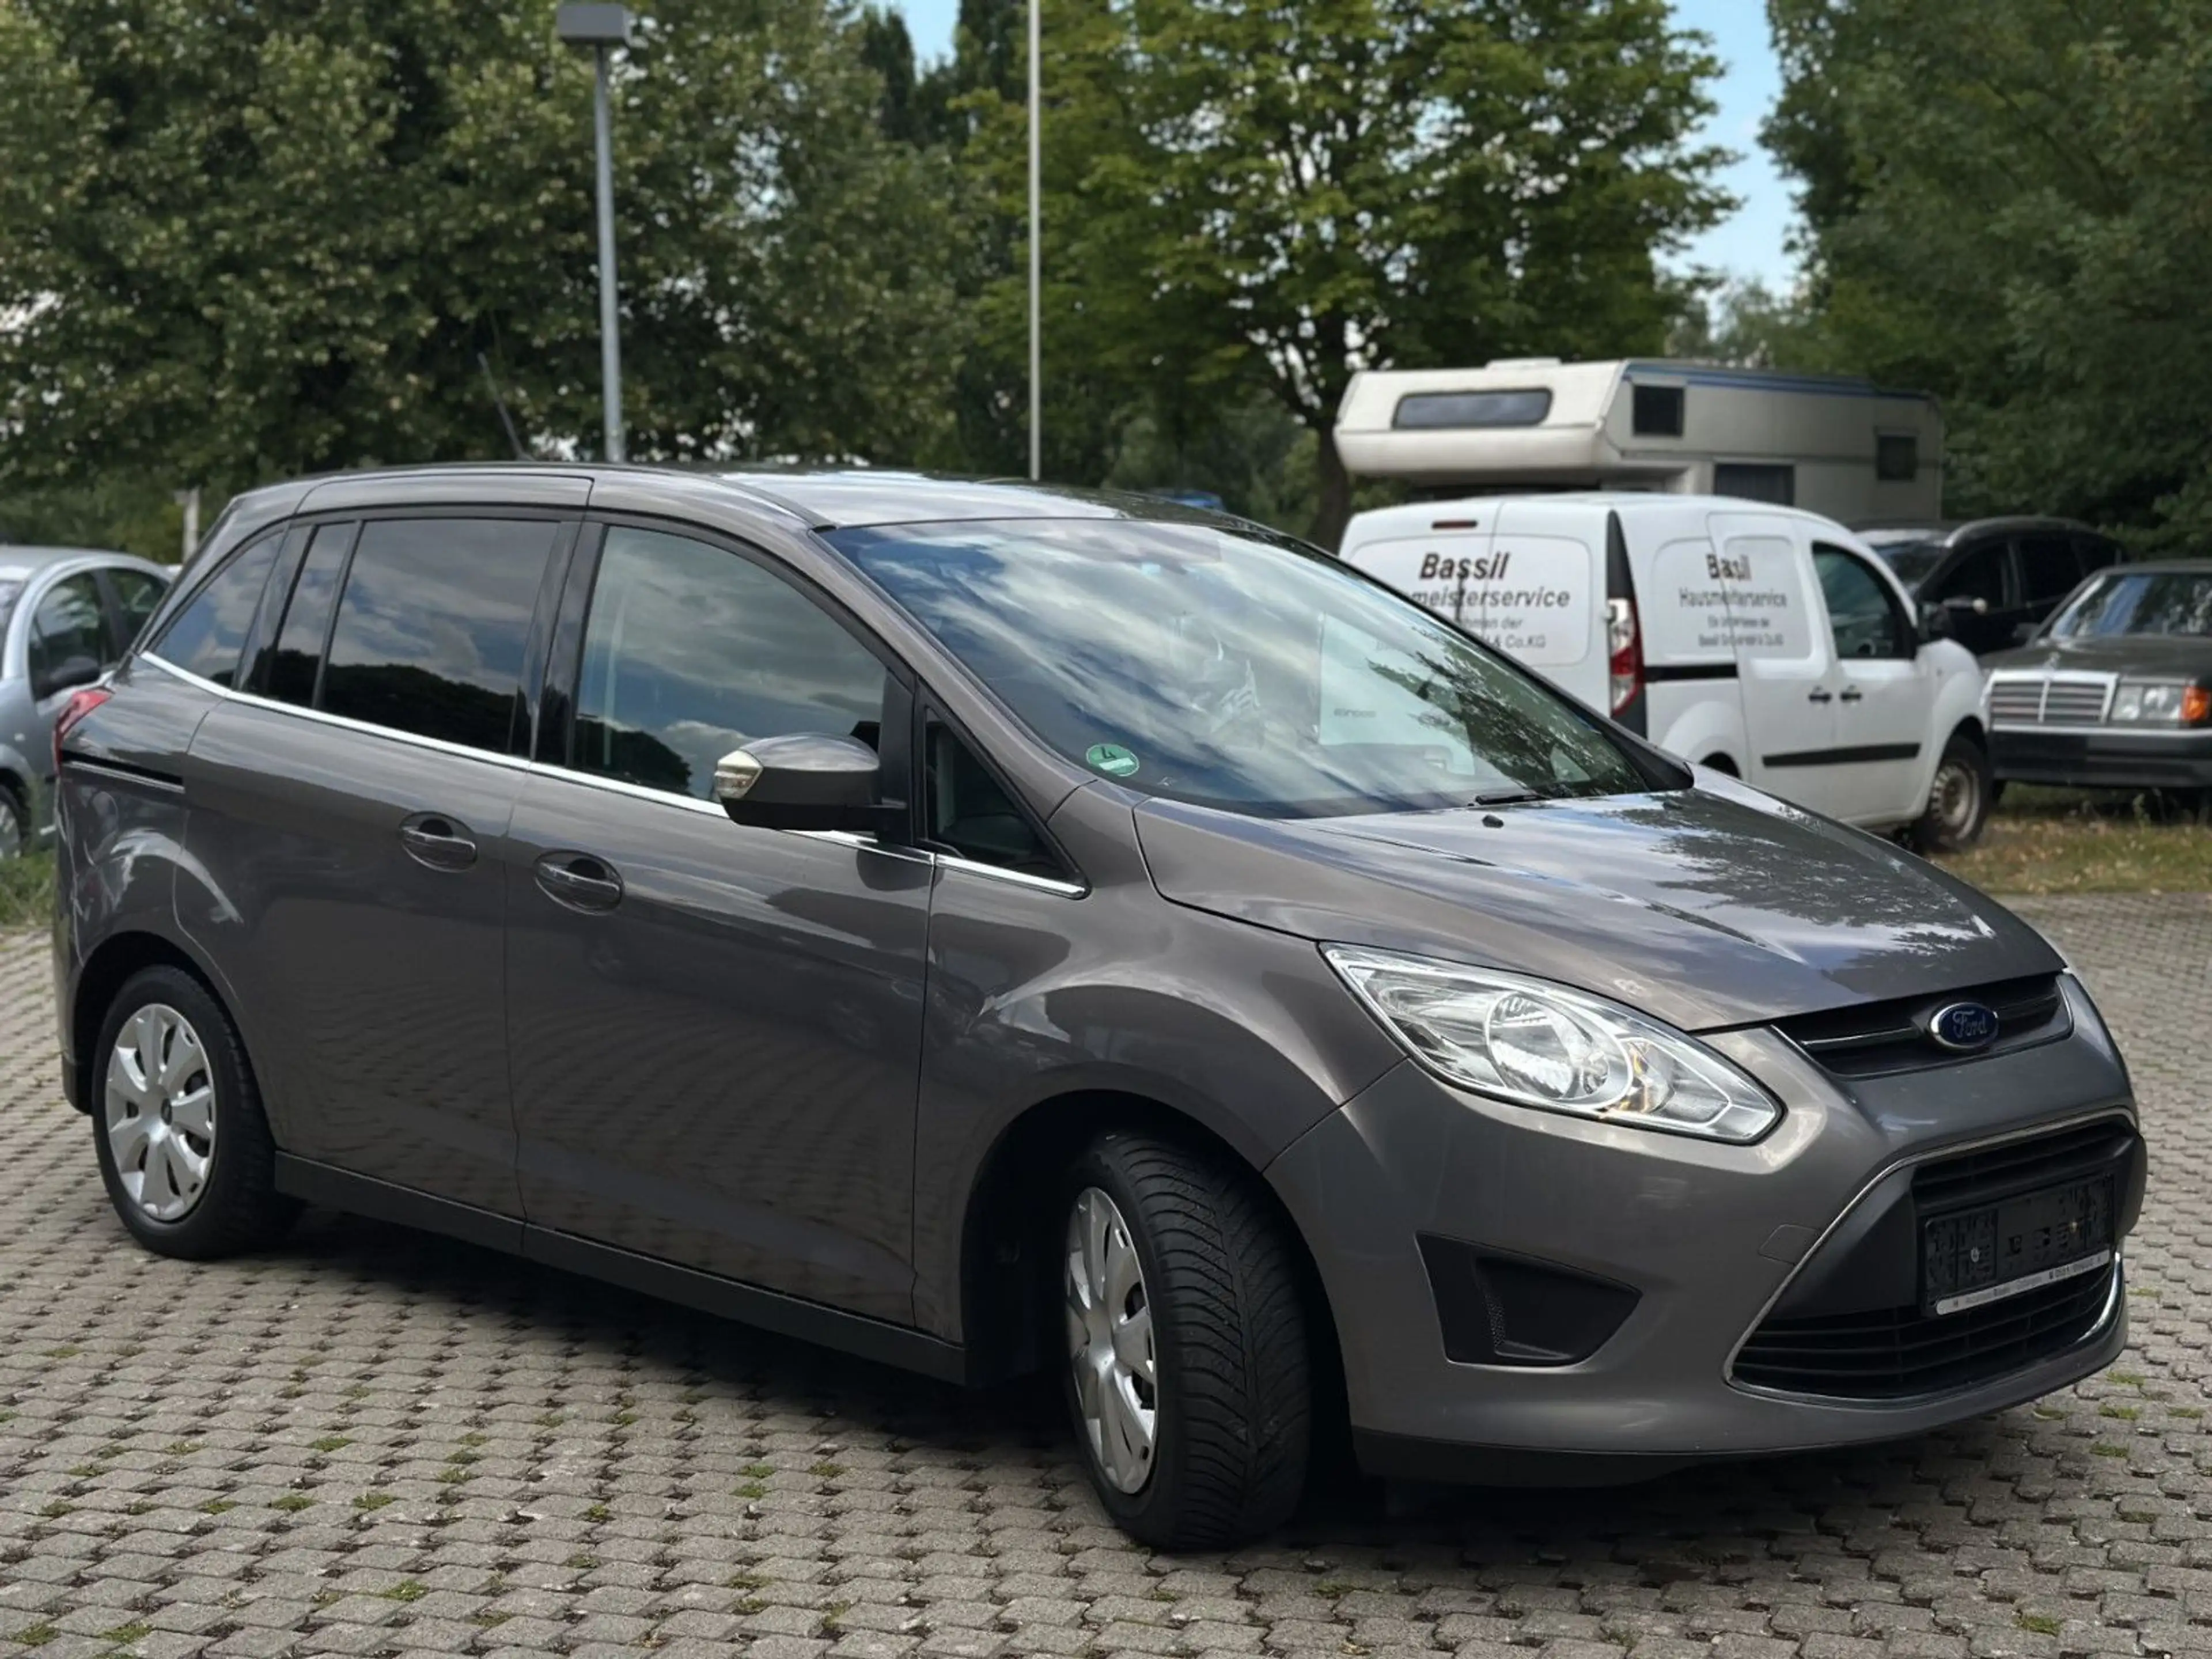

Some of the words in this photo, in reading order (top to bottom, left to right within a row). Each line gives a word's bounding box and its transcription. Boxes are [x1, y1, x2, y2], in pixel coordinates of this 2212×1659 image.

[1419, 551, 1510, 580] Bassil
[1411, 585, 1571, 608] meisterservice
[1952, 1010, 1988, 1039] Ford
